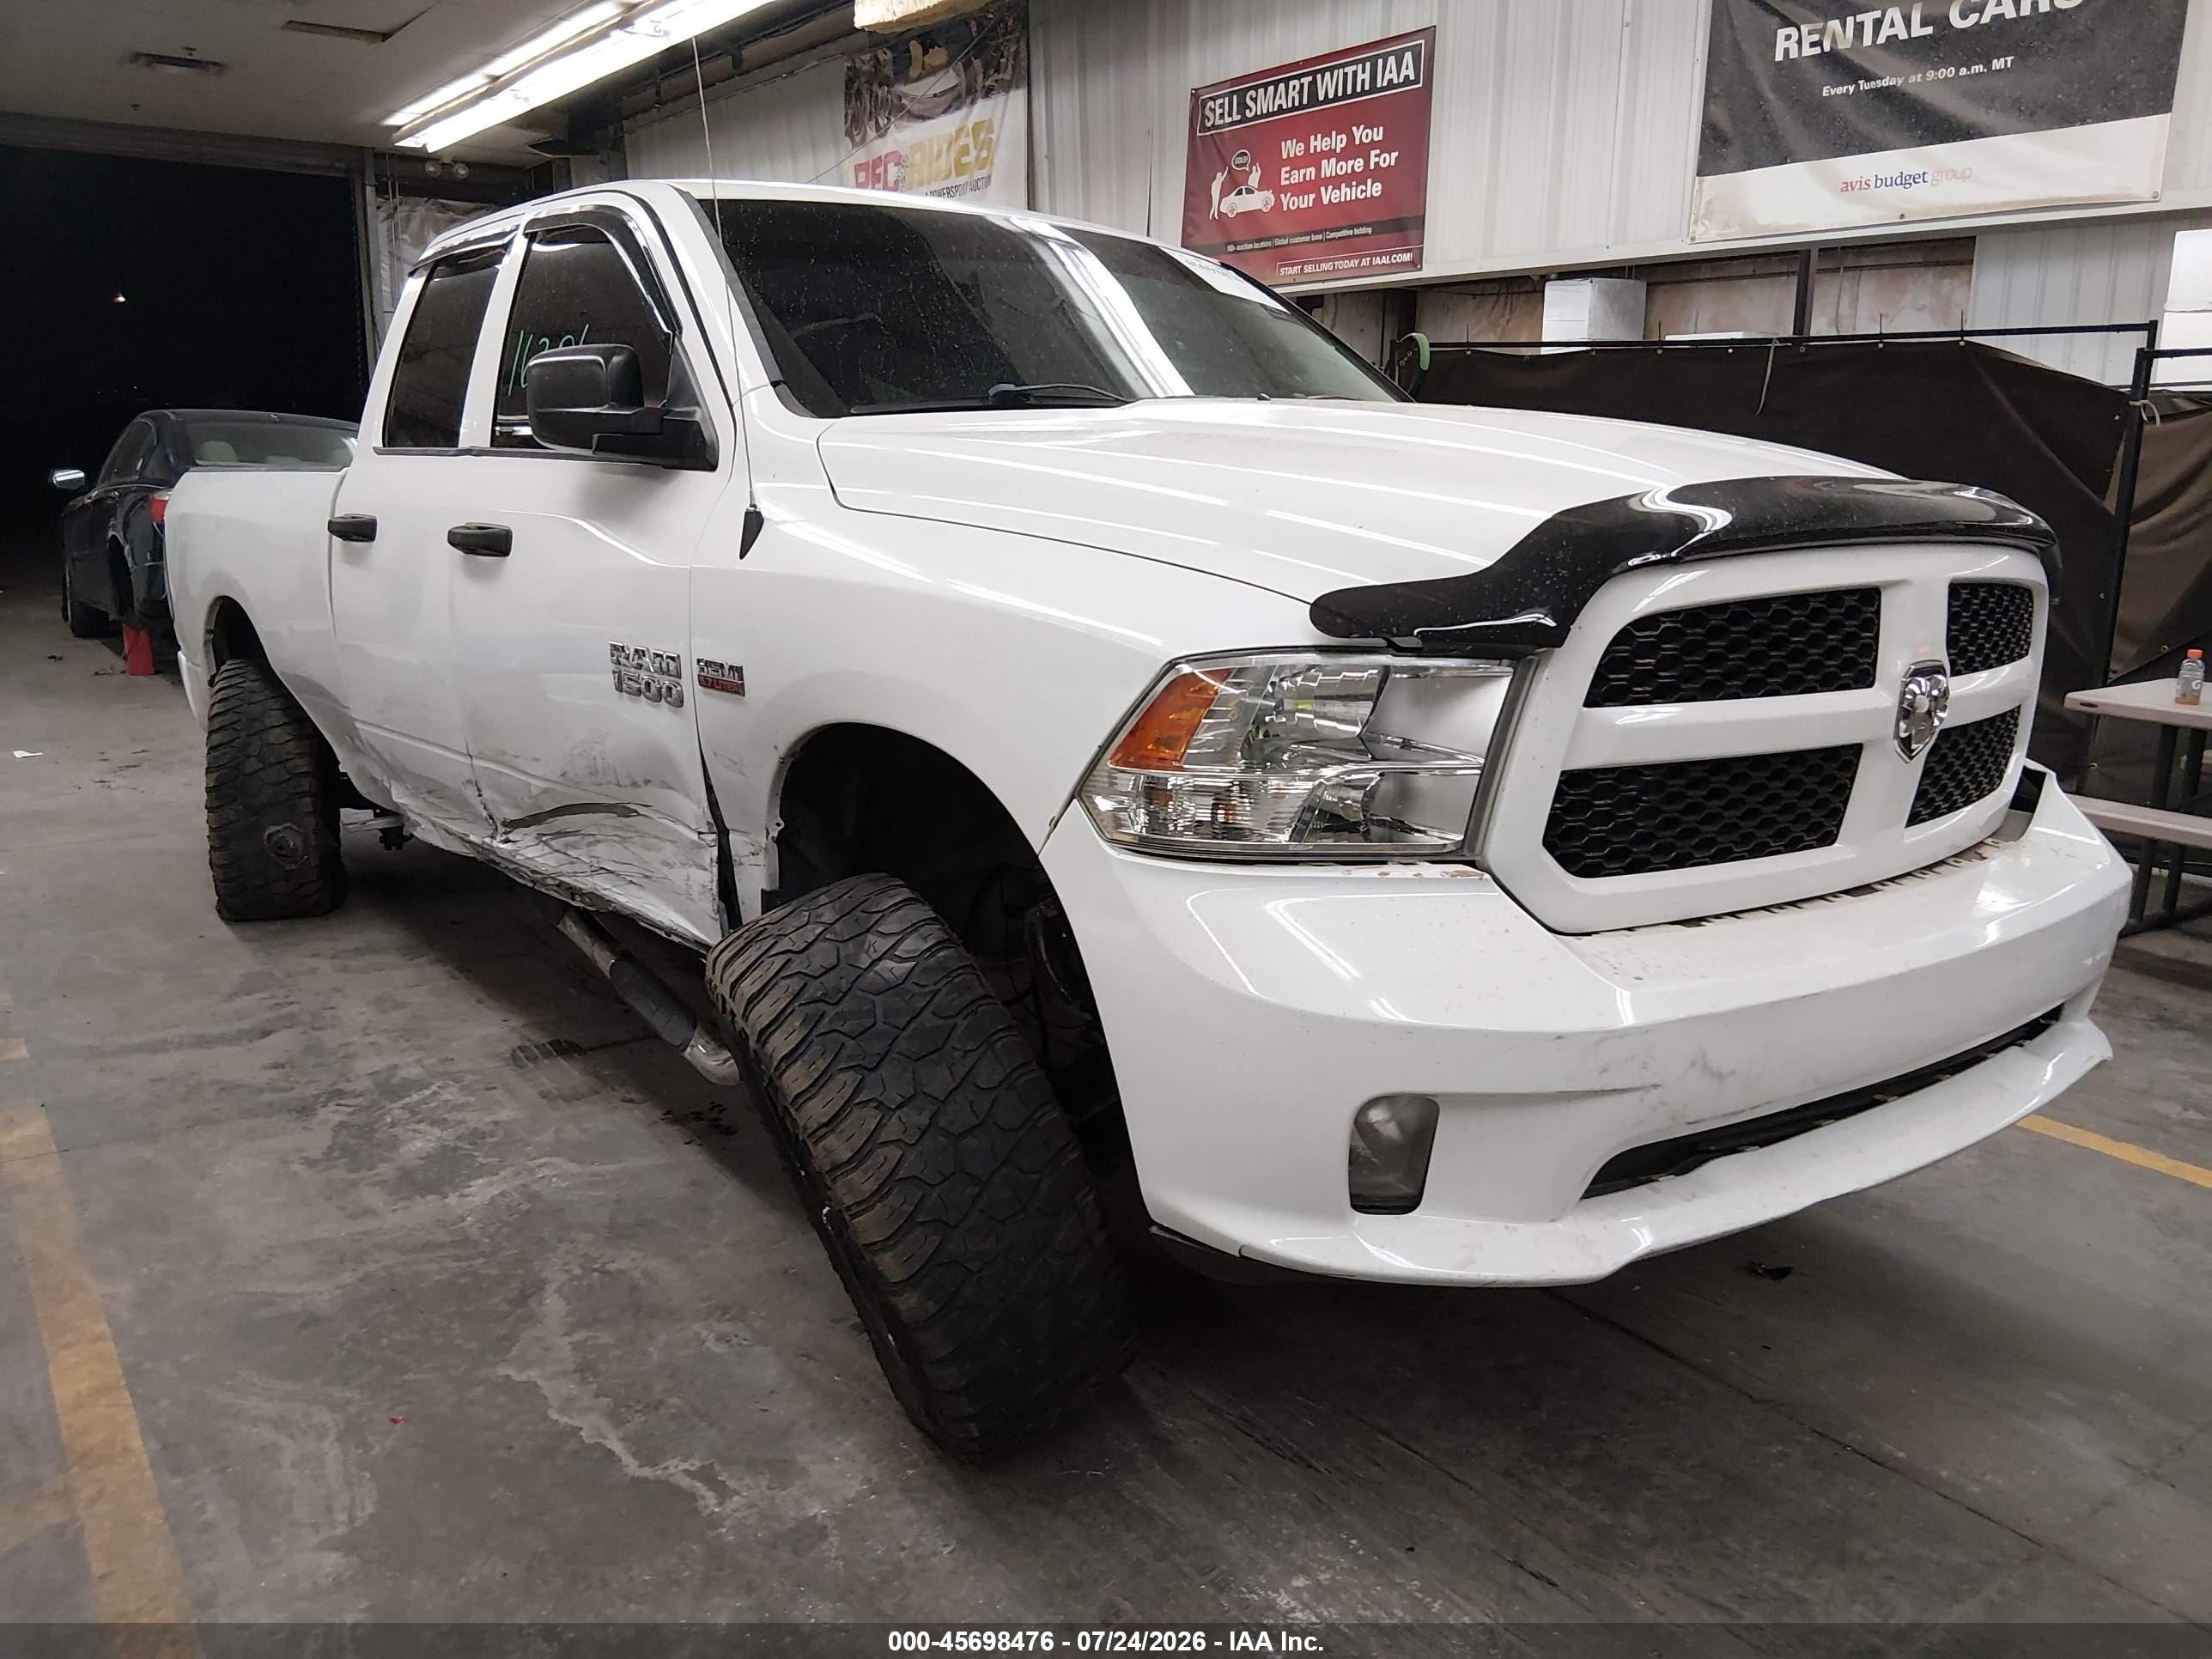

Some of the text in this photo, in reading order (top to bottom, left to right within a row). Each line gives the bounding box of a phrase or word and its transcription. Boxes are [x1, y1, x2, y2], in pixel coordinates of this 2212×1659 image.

[1774, 0, 2083, 62] RENTAL CA
[1204, 51, 1415, 128] SELL SMART WITH IAA
[1822, 56, 2014, 97] Every Tuesday at 9:00 a.m. MT
[906, 118, 994, 191] RIDES
[1280, 124, 1383, 160] We Help You
[1280, 149, 1399, 186] Earn More For
[1840, 167, 1972, 192] avis budget group
[1279, 179, 1382, 212] Your Vehicle
[1279, 252, 1413, 276] START SELLING TODAY AT IAAI.COM!
[608, 641, 682, 679] RAM
[611, 668, 684, 708] 1500
